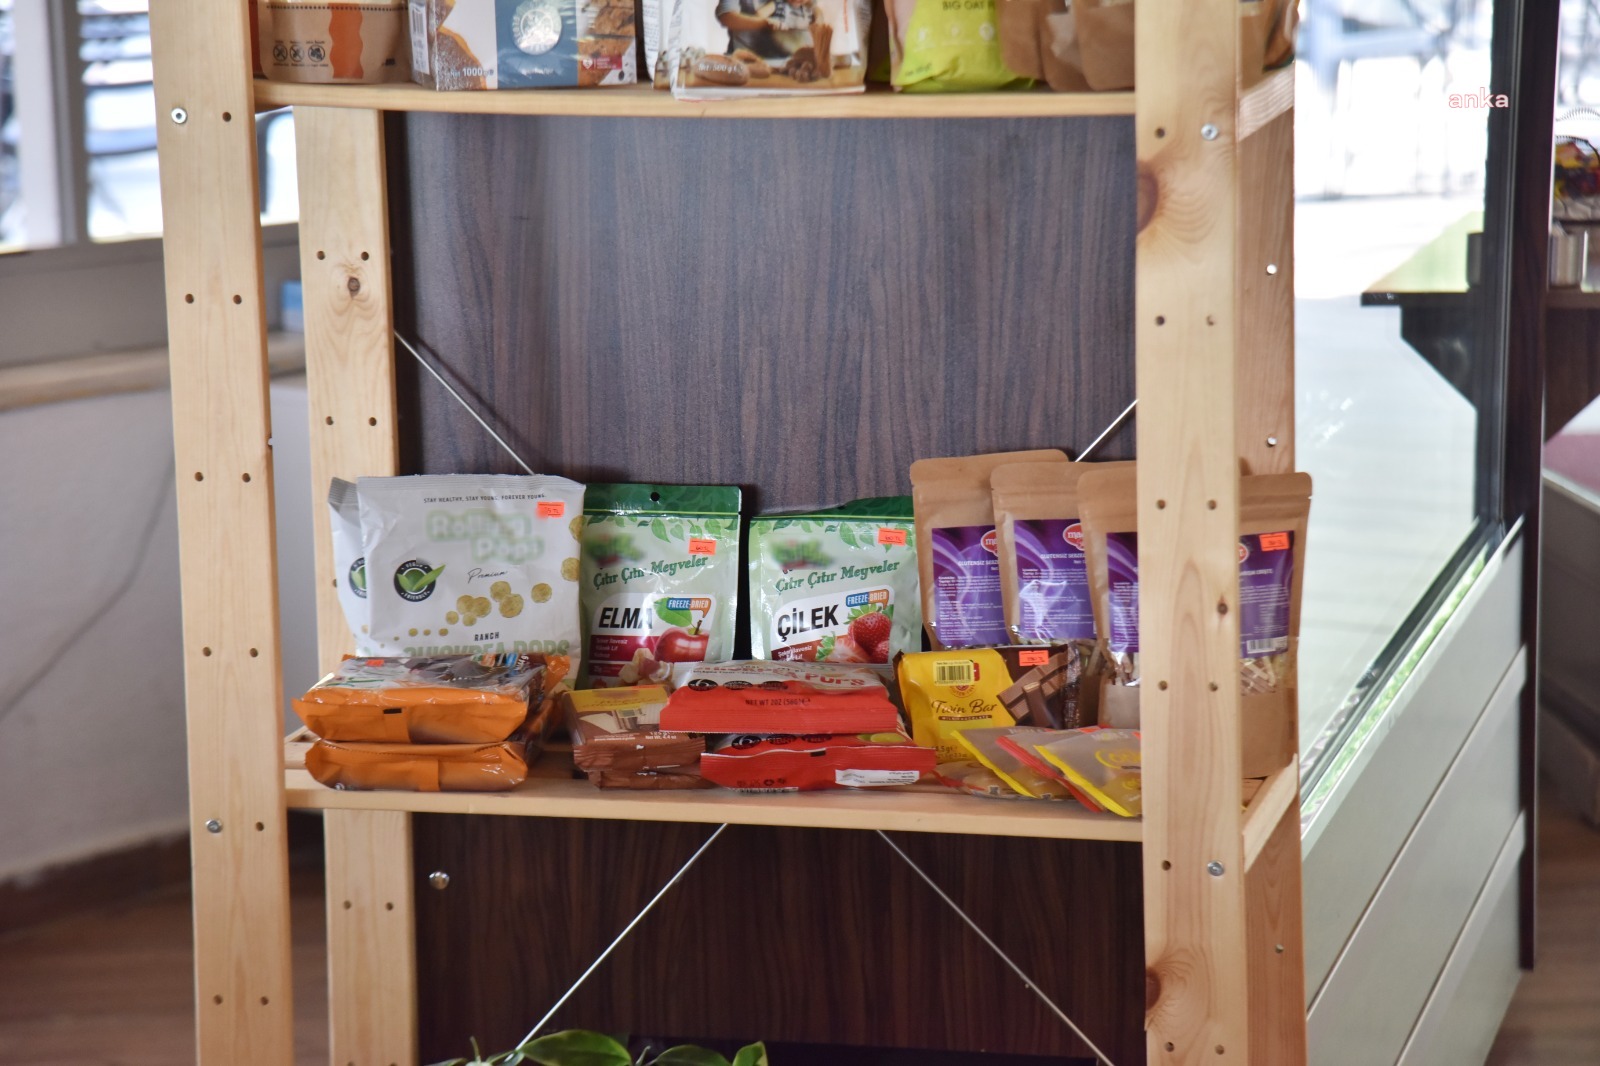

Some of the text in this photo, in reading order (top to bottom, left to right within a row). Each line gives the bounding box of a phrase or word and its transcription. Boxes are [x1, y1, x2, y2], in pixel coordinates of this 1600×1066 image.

[942, 1, 960, 10] BIG
[964, 0, 984, 10] OAT
[463, 67, 482, 76] 1000
[650, 554, 708, 576] Meyveler
[467, 567, 508, 584] Premium
[807, 571, 837, 589] Çıtır
[840, 559, 900, 584] Meyveler
[668, 599, 709, 608] FREEZE-DRIED
[847, 589, 888, 606] FREEZE-DRIED
[598, 607, 653, 629] ELMA
[777, 604, 839, 642] ÇİLEK
[474, 632, 500, 641] RANCH
[931, 698, 998, 714] Twin Bar
